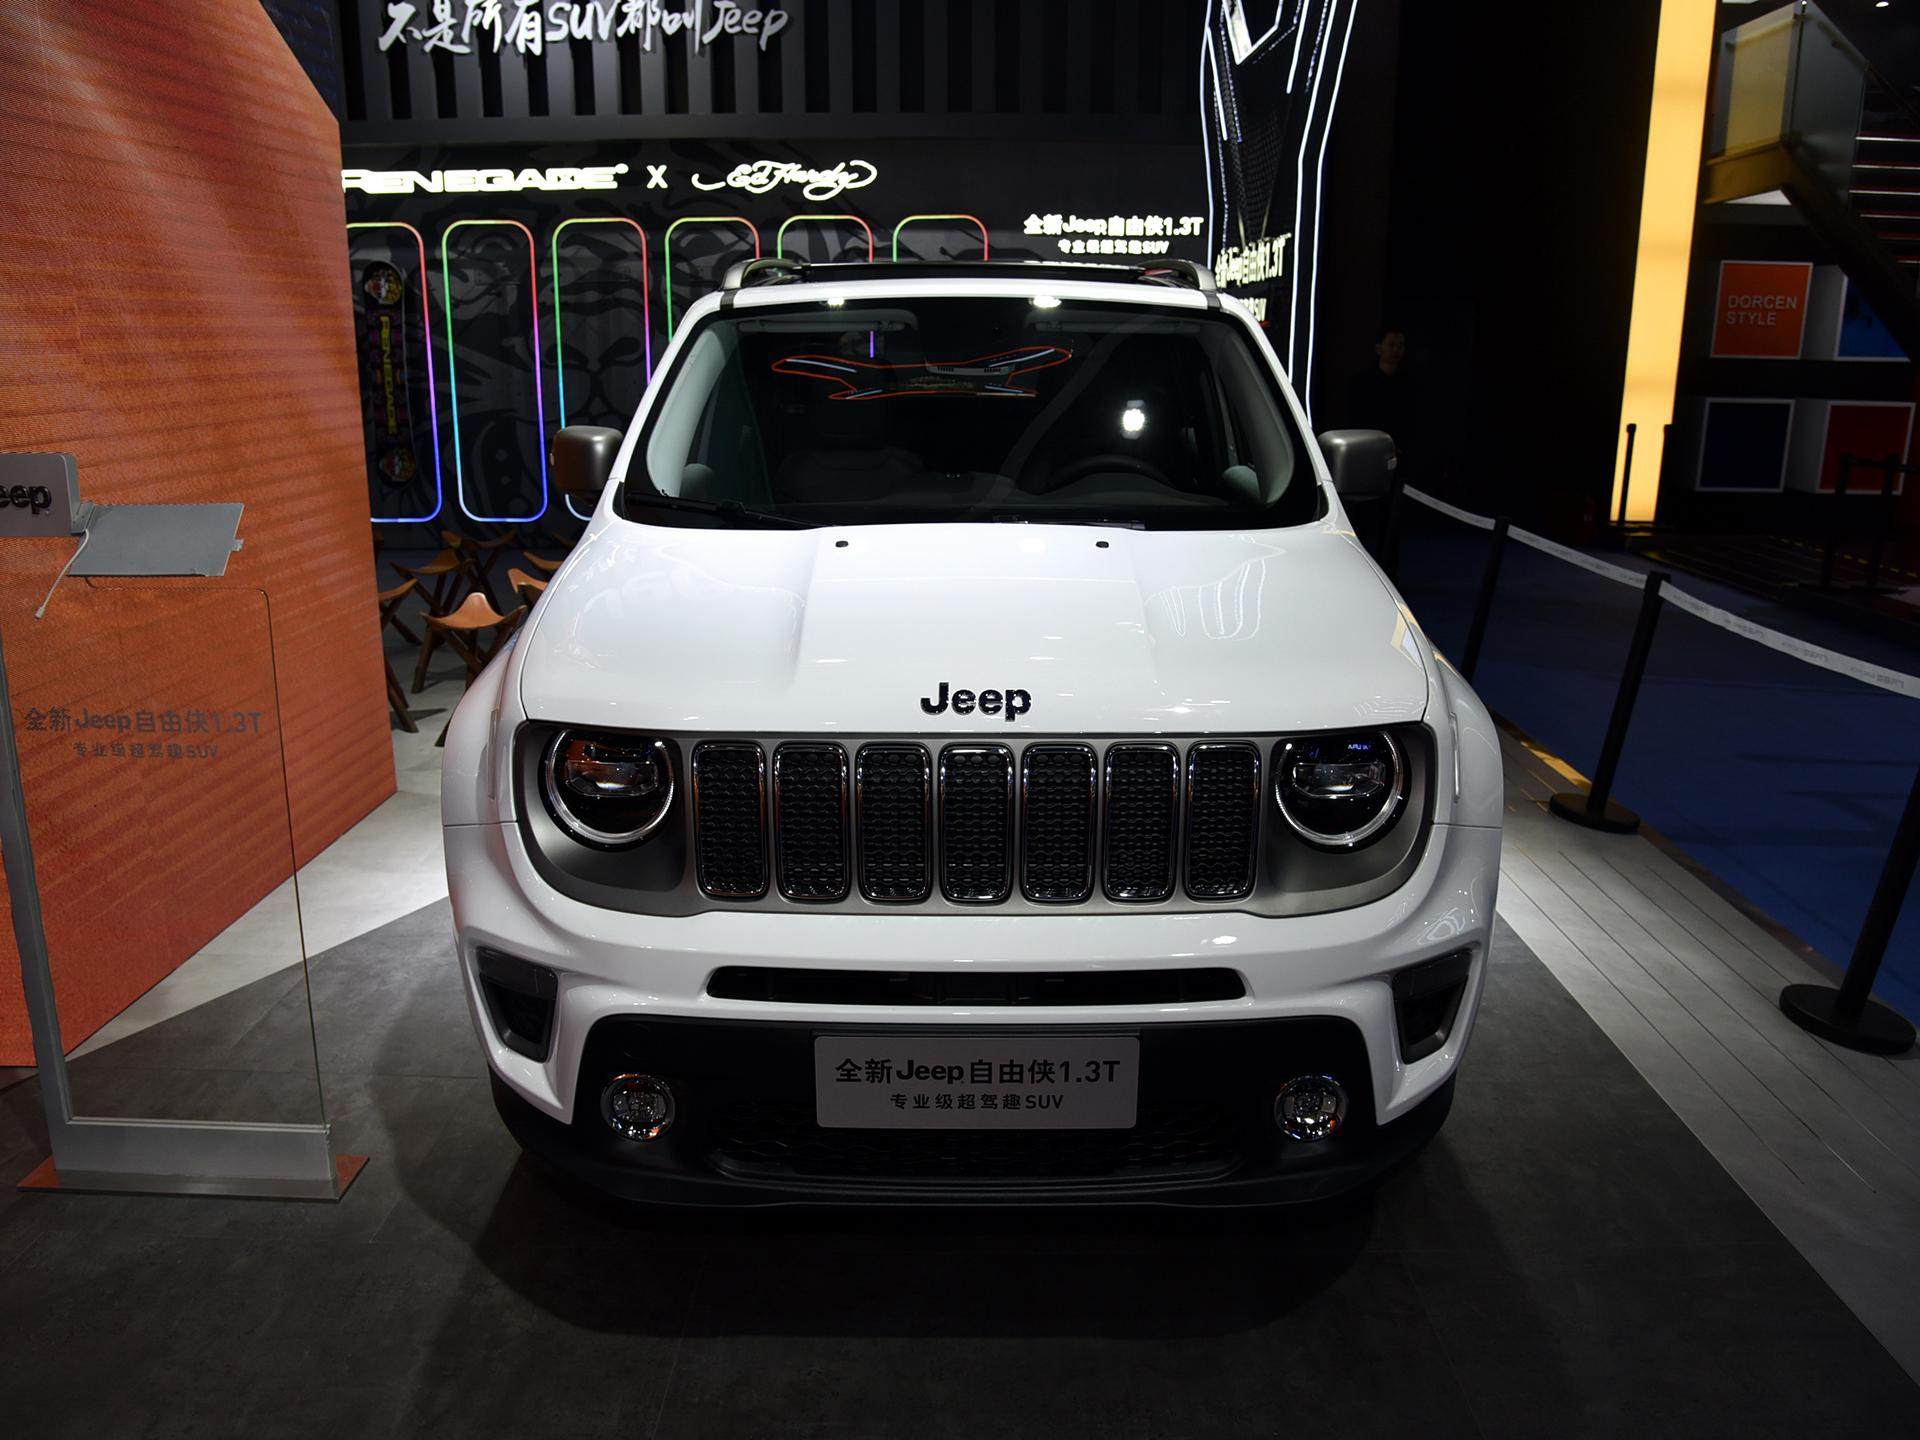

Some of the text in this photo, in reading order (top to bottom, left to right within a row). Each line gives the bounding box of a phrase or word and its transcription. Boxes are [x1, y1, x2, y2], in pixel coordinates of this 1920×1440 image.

[1727, 295, 1797, 310] DORCEN
[1726, 311, 1777, 326] STYLE
[920, 682, 1032, 722] Jeep
[24, 706, 263, 735] 全新Jeep自由侠1.3T
[835, 1058, 1121, 1086] 全新Jeep自由侠1.3T
[890, 1093, 1065, 1111] 专业级超驾趣SUV
